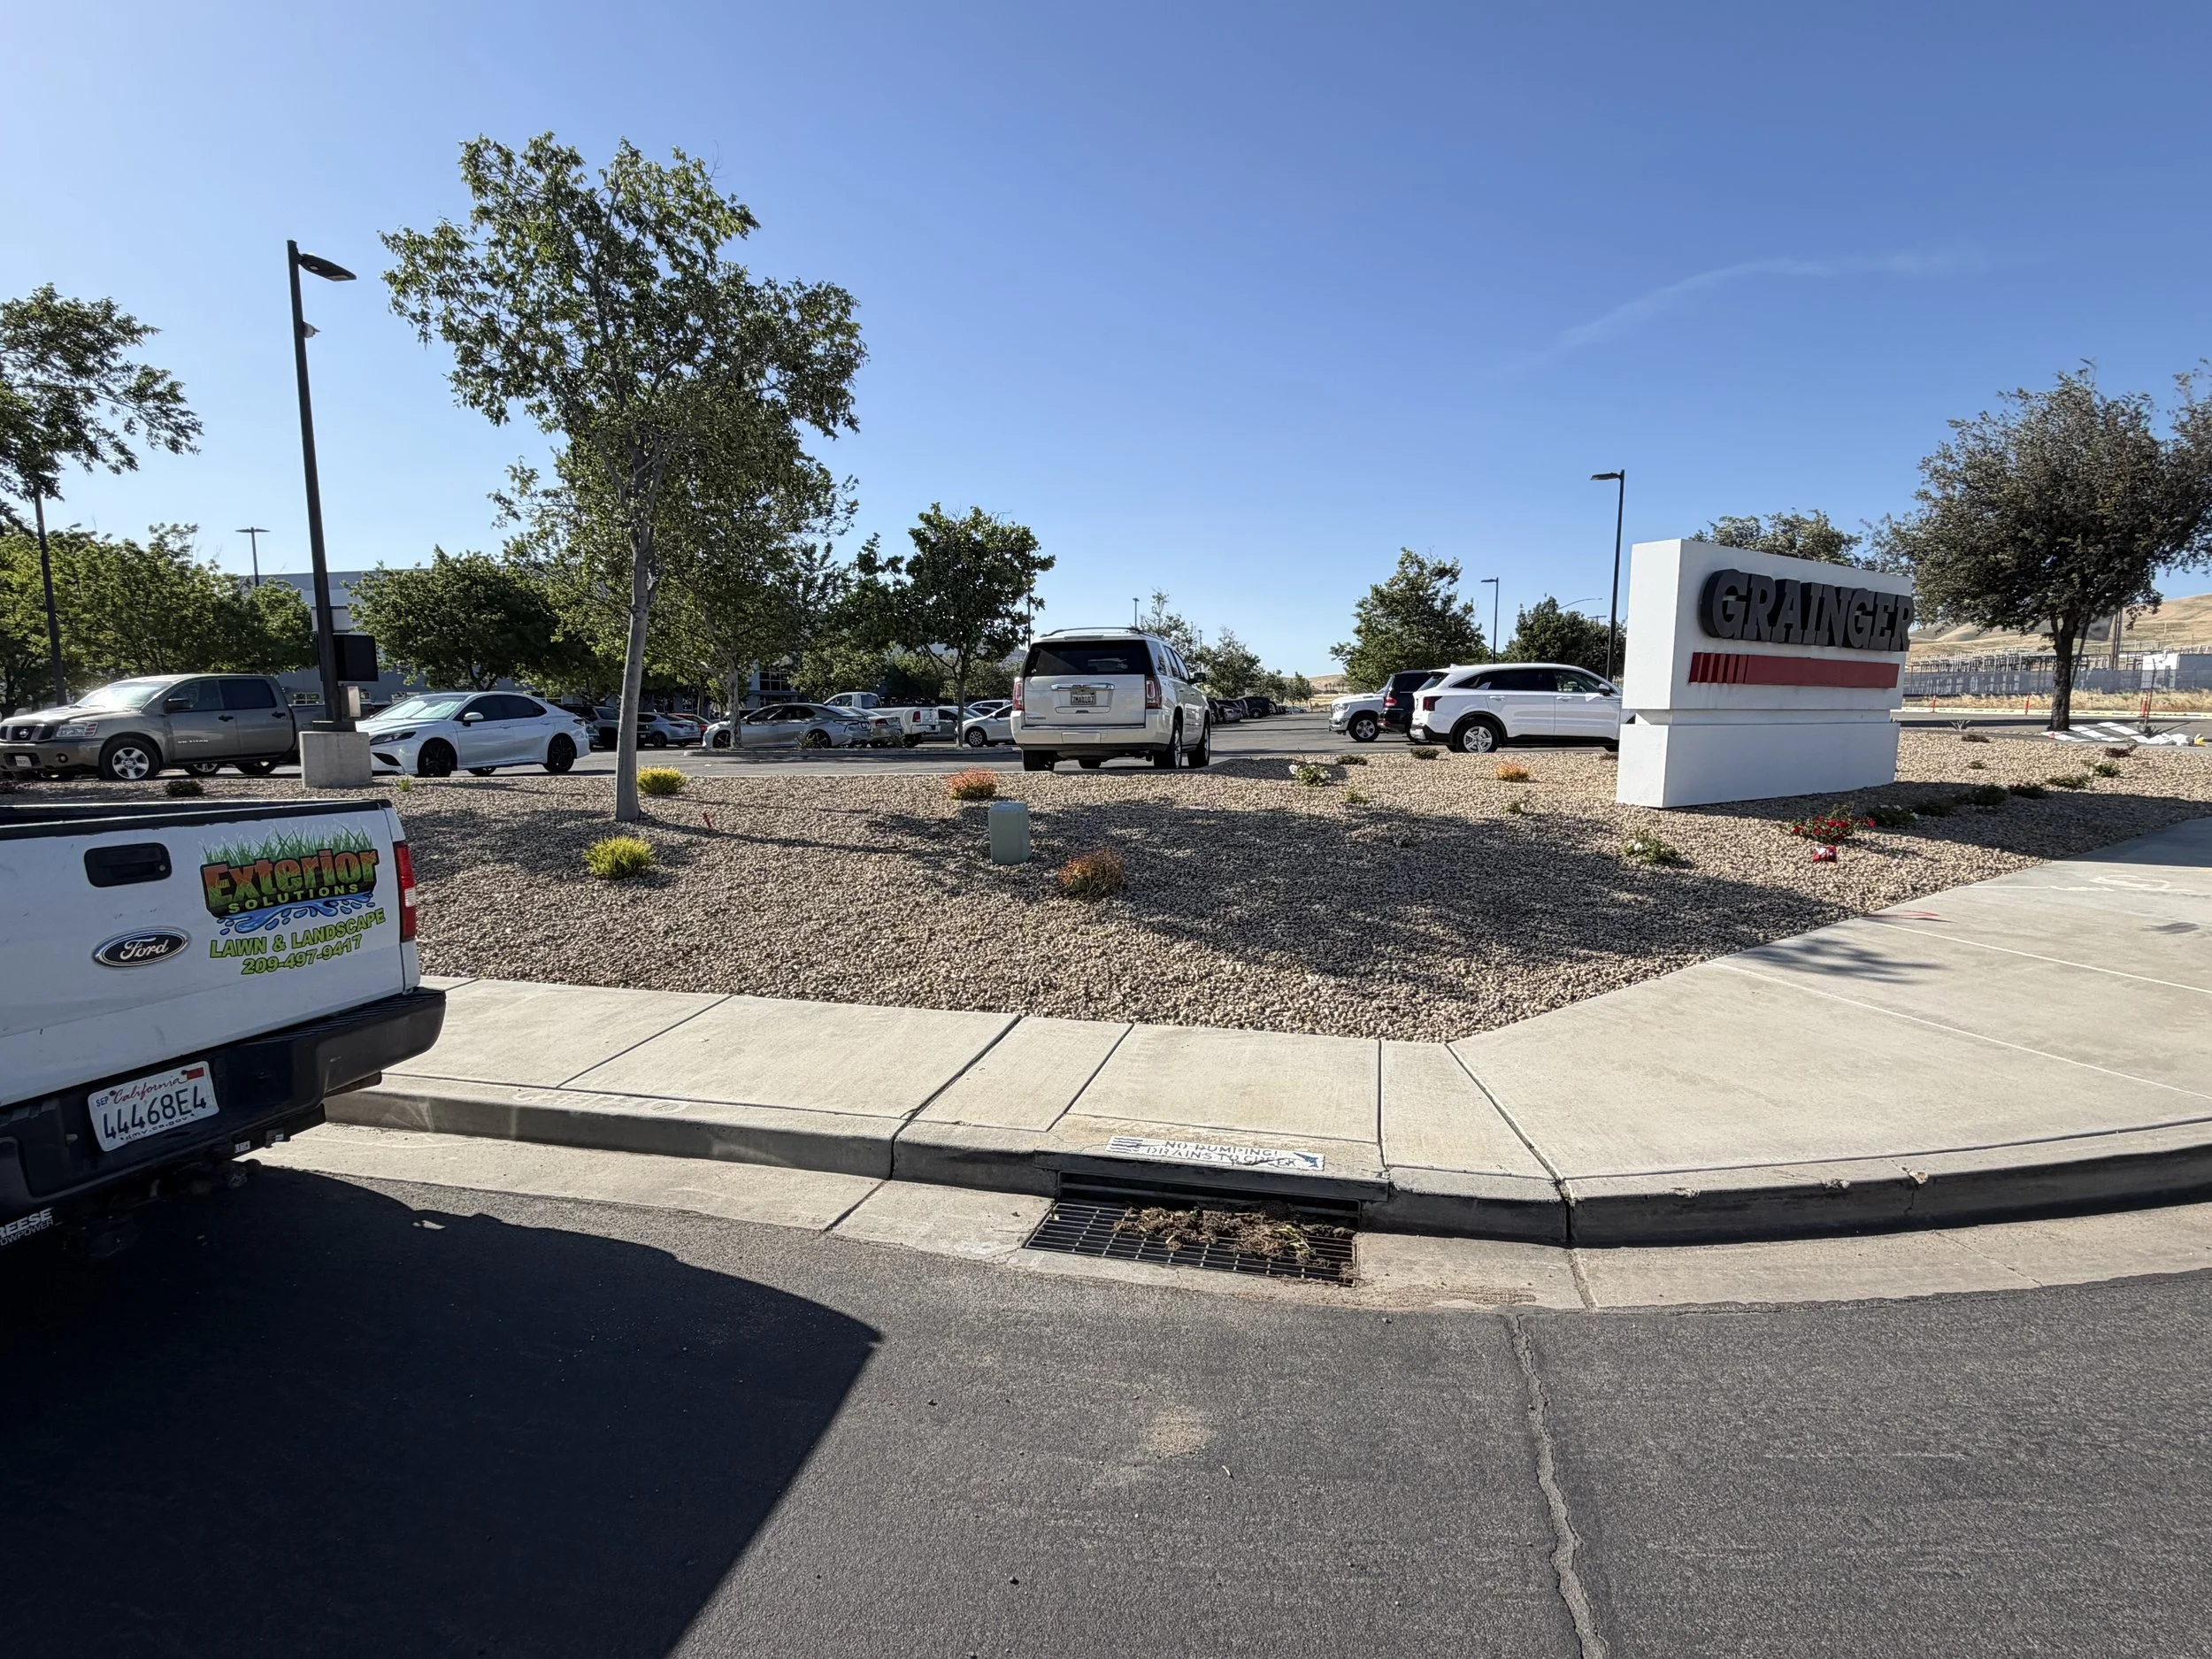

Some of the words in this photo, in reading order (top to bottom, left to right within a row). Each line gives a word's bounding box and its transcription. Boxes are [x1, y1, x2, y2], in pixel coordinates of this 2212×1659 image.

[1701, 569, 1914, 651] GRAINGER
[203, 849, 379, 909] Exterior
[228, 884, 359, 913] SOLUTIONS
[210, 935, 267, 958] LAWN
[272, 934, 287, 952] &
[291, 908, 386, 949] LANDSCAPE
[119, 936, 170, 960] Ford
[241, 934, 363, 975] 209-497-9417
[96, 1096, 109, 1108] SEP
[112, 1076, 188, 1104] California
[104, 1086, 207, 1139] 44468E4
[1147, 1148, 1213, 1159] DRAINS
[1165, 1141, 1187, 1149] NO
